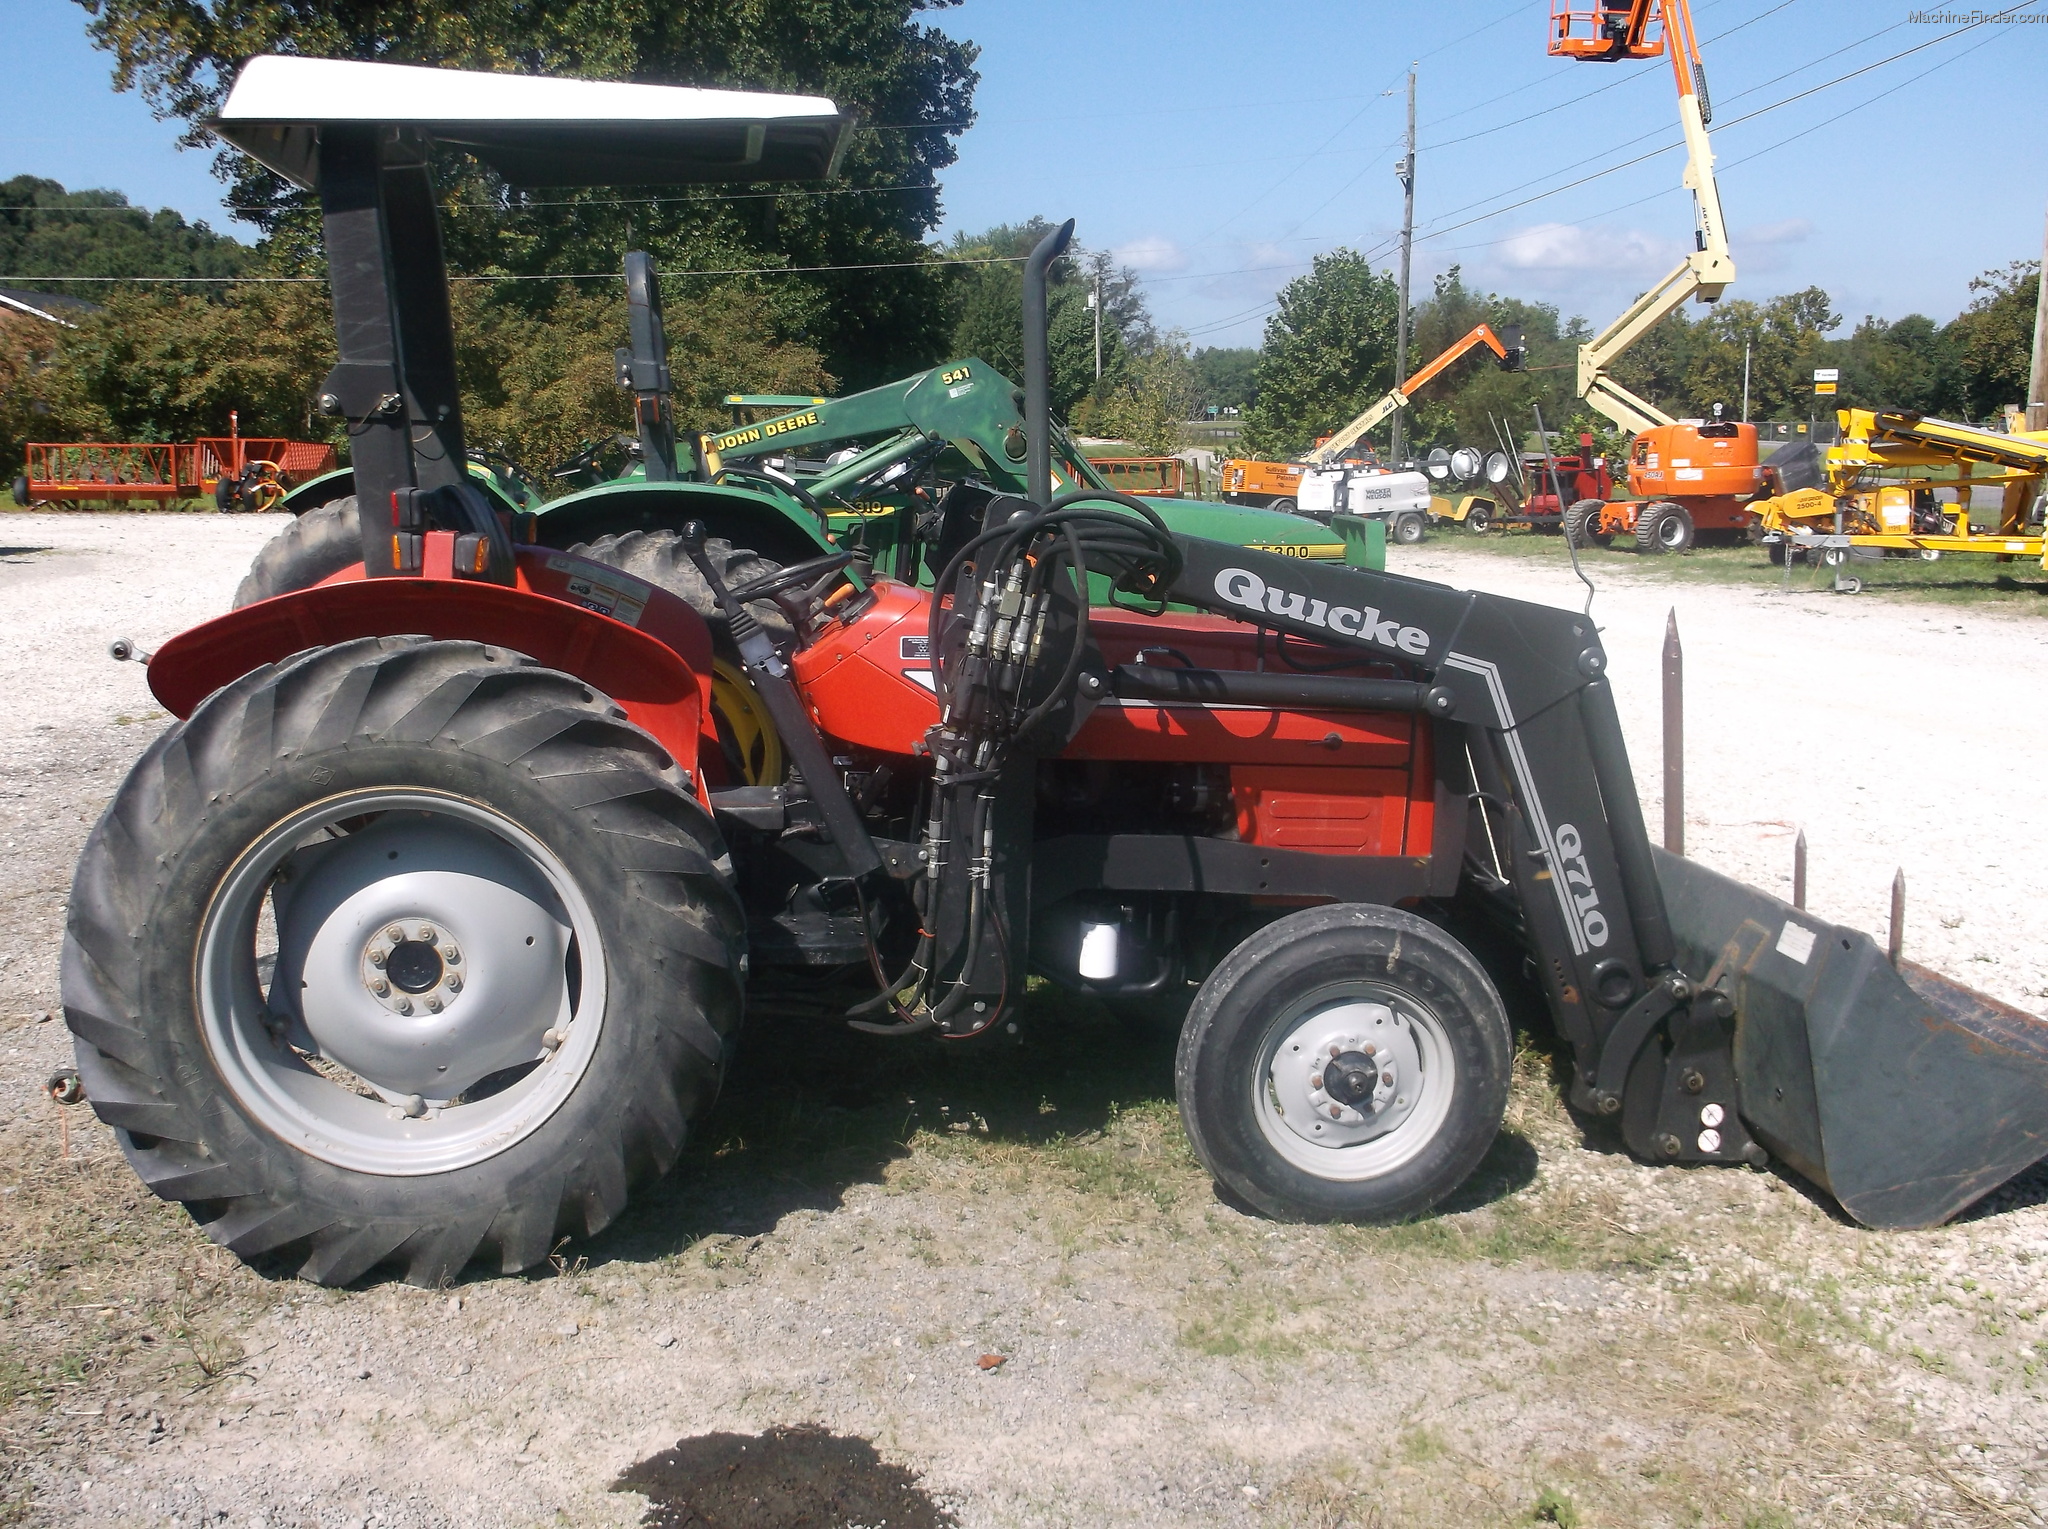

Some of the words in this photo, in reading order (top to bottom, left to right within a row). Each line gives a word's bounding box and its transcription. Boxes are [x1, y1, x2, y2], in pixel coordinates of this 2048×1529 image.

[941, 366, 971, 385] 541
[1382, 401, 1394, 414] JLG
[717, 428, 761, 451] JOHN
[765, 412, 818, 437] DEERE
[1797, 500, 1822, 510] 2500-4
[1213, 567, 1430, 656] Quicke
[1556, 823, 1609, 947] Q710
